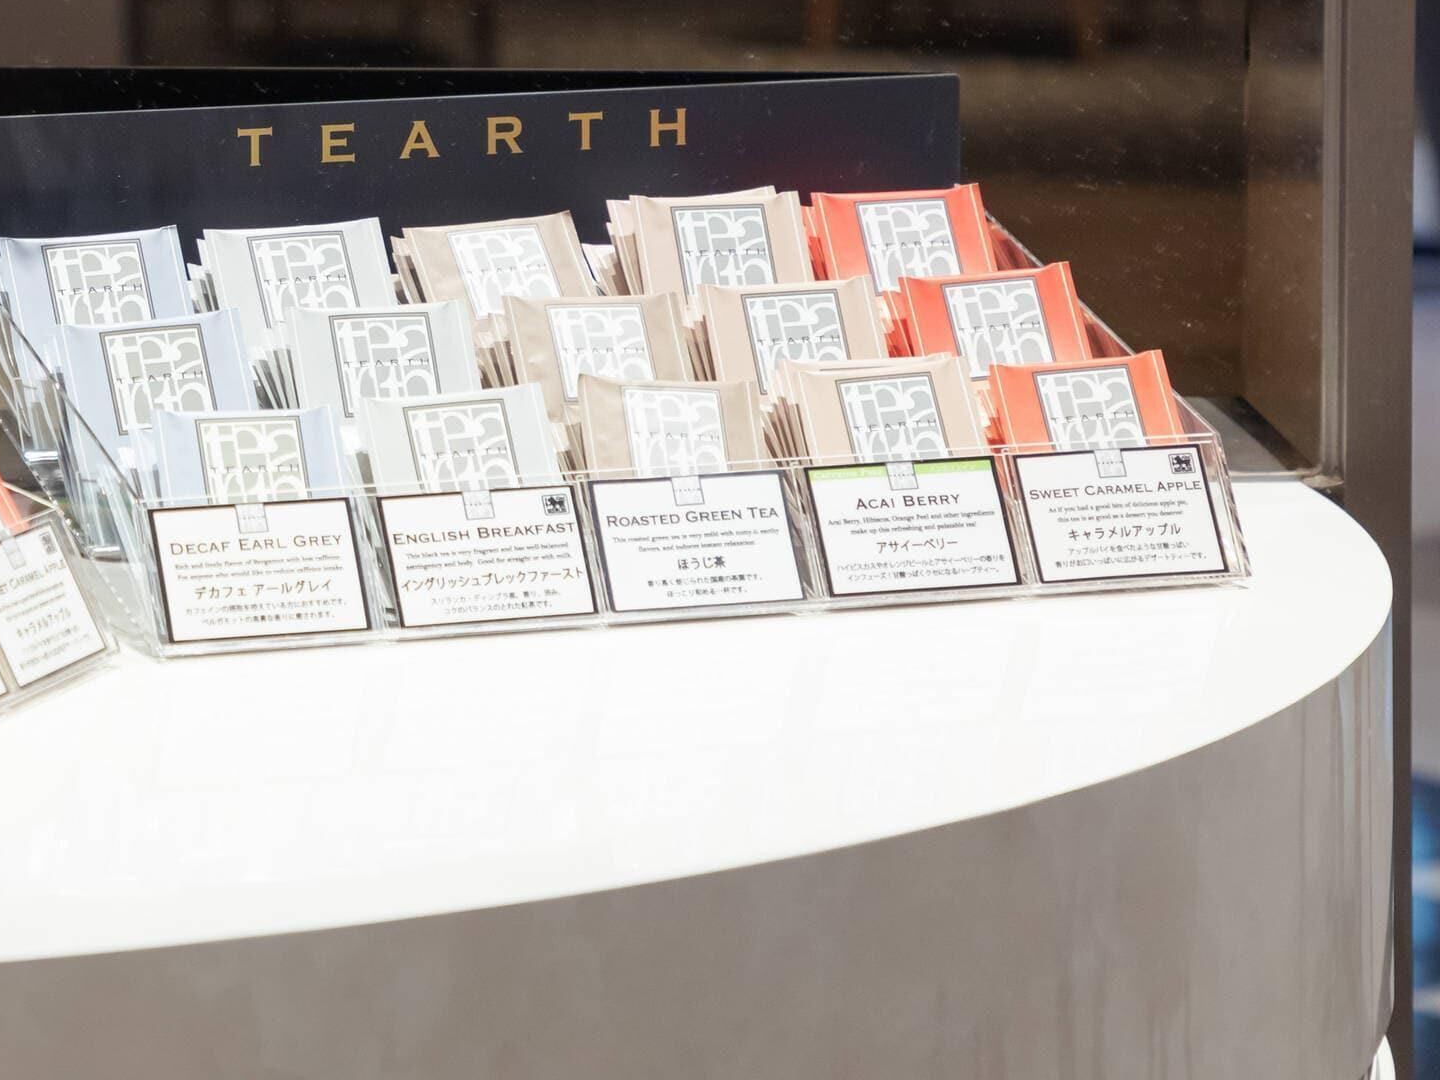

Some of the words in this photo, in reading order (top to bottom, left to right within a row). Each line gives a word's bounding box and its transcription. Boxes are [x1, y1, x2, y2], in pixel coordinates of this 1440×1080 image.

[237, 107, 687, 166] TEARTH
[684, 247, 767, 257] TEARTH
[264, 273, 347, 286] TEARTH
[57, 283, 143, 296] TEARTH
[757, 334, 840, 346] TEARTH
[344, 358, 430, 368] TEARTH
[116, 370, 203, 385] TEARTH
[1050, 409, 1135, 424] TEARTH
[853, 419, 937, 432] TEARTH
[1028, 487, 1080, 500] SWEET
[1083, 483, 1153, 496] CARAMEL
[1157, 480, 1202, 492] APPLE
[856, 497, 895, 510] ACAI
[902, 493, 959, 507] BERRY
[605, 513, 680, 527] ROASTED
[685, 509, 742, 523] GREEN
[746, 506, 779, 519] TEA
[392, 529, 470, 545] ENGLISH
[476, 522, 574, 539] BREAKFAST
[1067, 522, 1181, 541] キャラメルアップル
[169, 541, 230, 555] DECAF
[238, 538, 287, 551] EARL
[292, 534, 341, 547] GREY
[875, 537, 958, 554] アサイーベリー
[677, 555, 726, 570] ほうじ茶
[9, 569, 45, 591] CARAMEL
[400, 565, 584, 592] イングリッシュブレックファースト
[194, 585, 247, 600] デカフェ
[252, 578, 332, 596] アールグレイ
